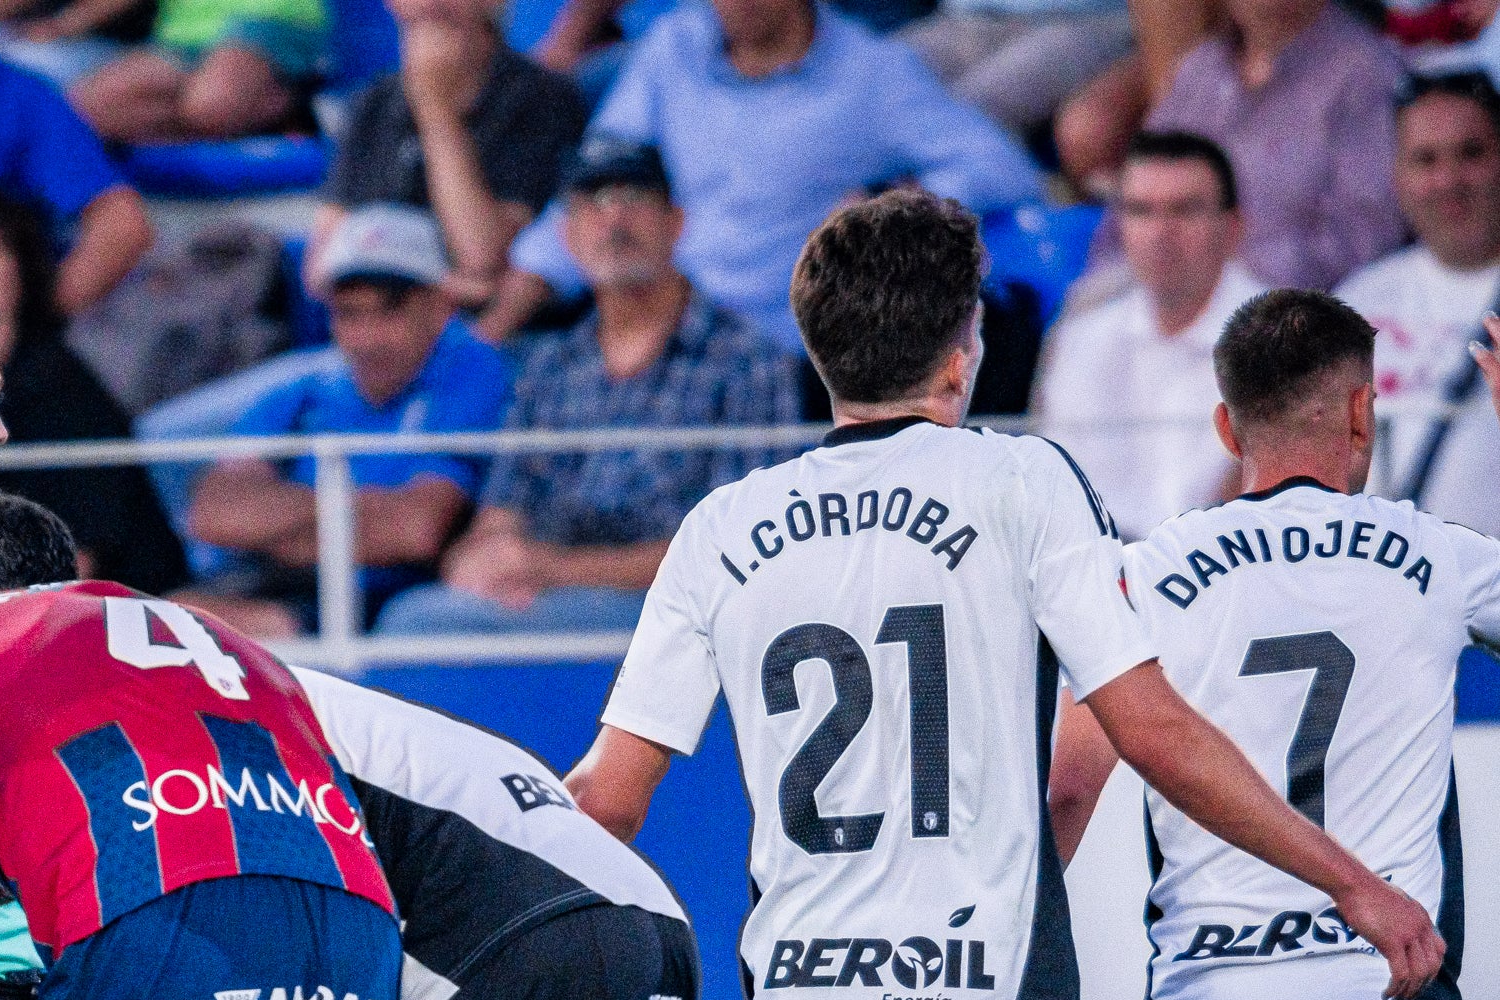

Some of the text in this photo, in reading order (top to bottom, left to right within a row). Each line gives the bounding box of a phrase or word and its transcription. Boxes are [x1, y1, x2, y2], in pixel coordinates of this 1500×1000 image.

[104, 595, 251, 701] 4
[760, 604, 950, 855] 21
[1237, 630, 1357, 832] 7
